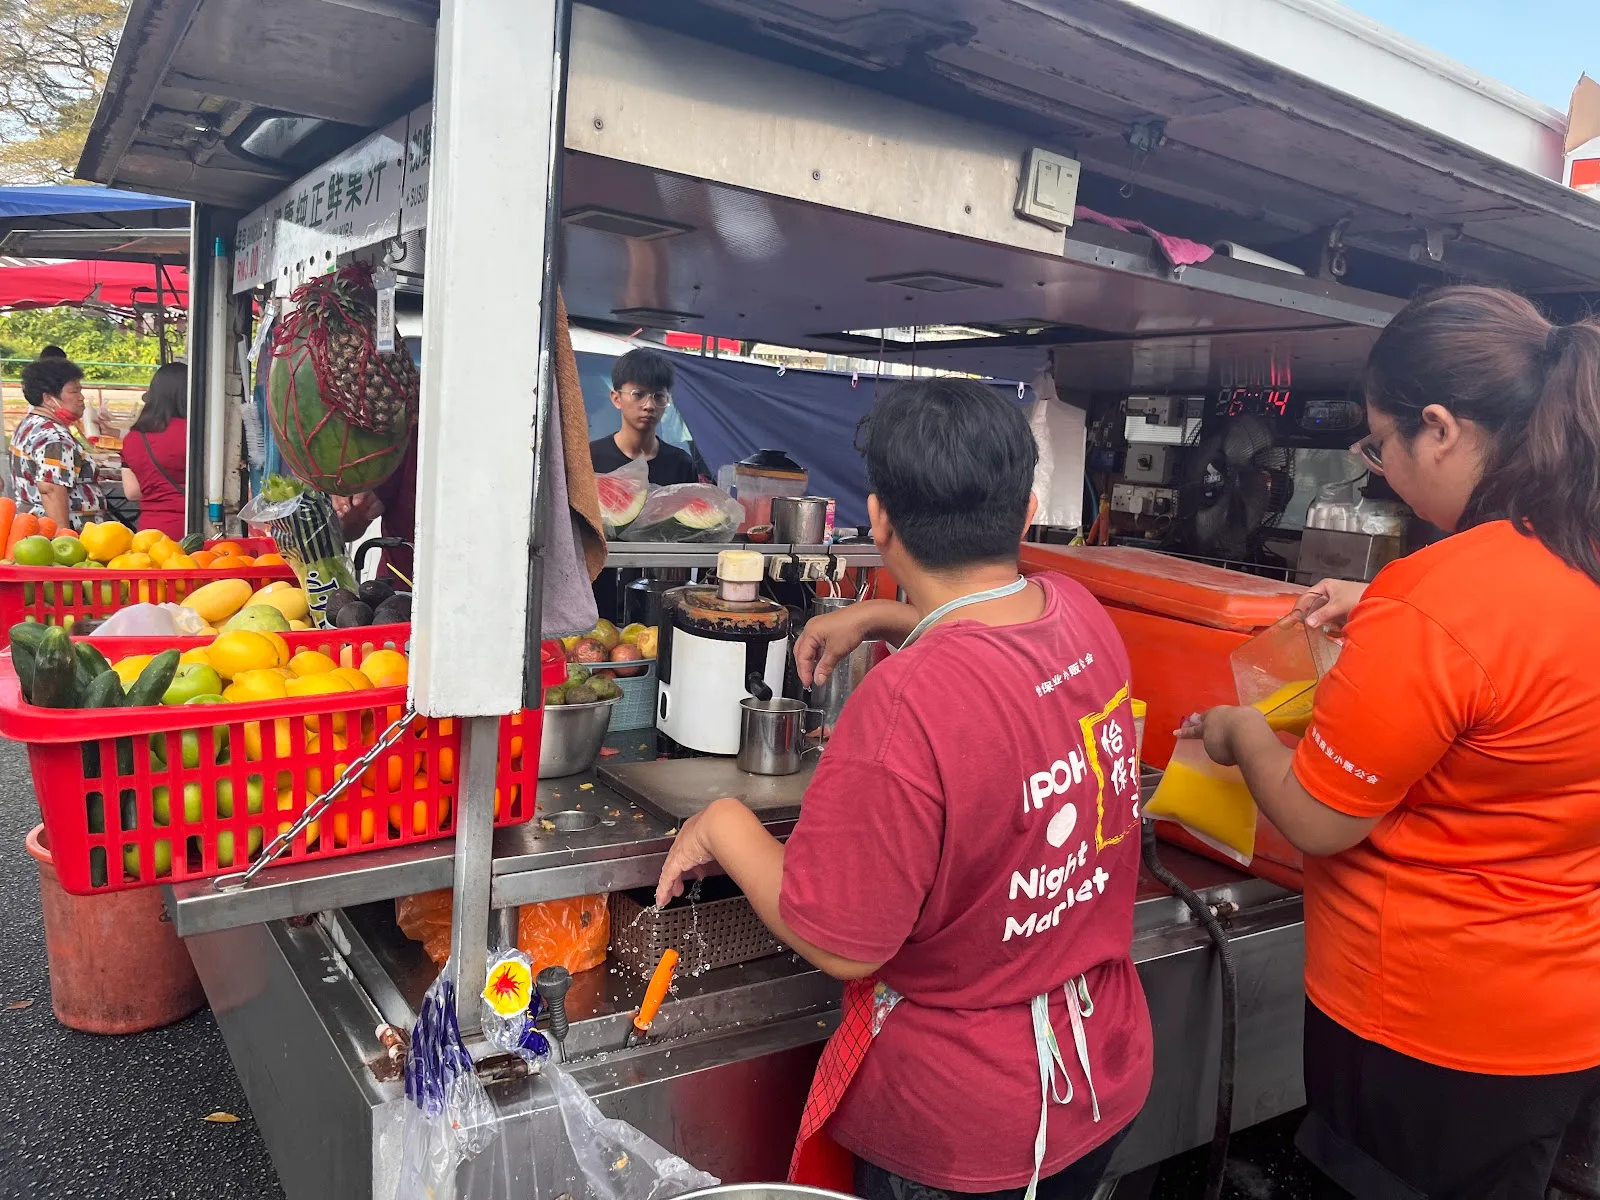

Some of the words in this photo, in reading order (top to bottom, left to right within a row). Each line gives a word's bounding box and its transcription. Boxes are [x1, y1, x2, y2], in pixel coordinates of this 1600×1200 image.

[272, 159, 388, 250] 康纯正鲜果汁
[1022, 743, 1088, 814] IPOH
[1008, 840, 1088, 900] Night
